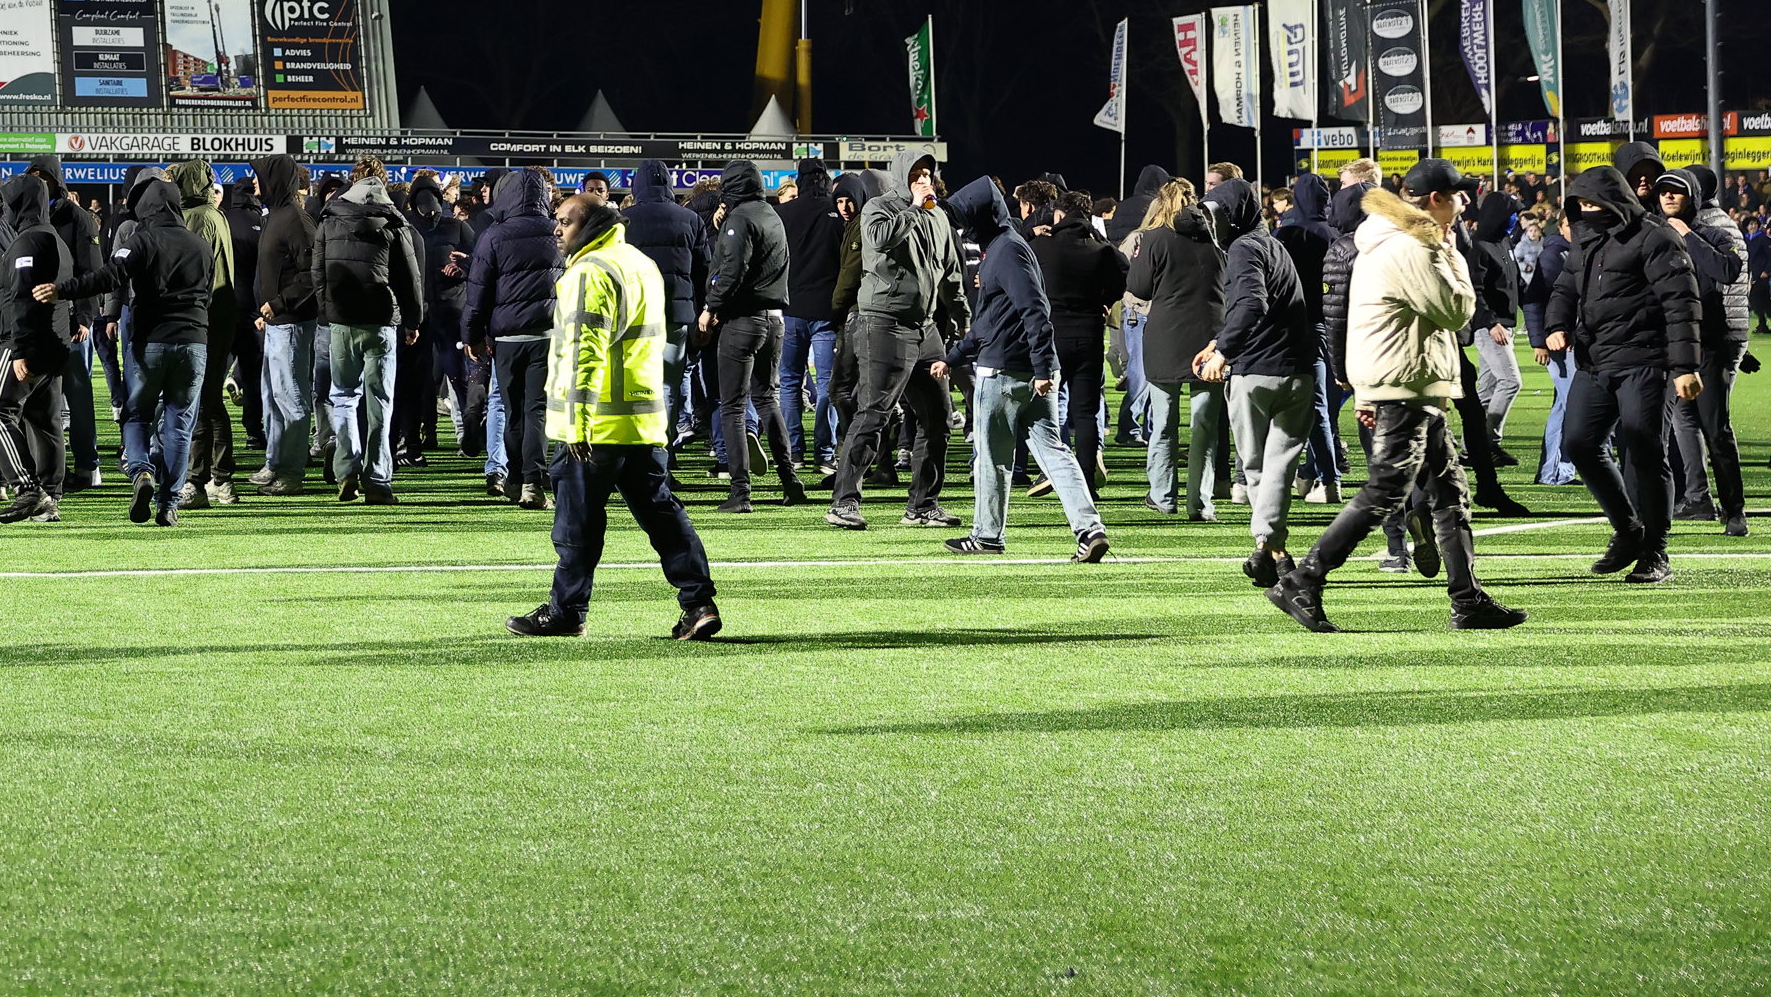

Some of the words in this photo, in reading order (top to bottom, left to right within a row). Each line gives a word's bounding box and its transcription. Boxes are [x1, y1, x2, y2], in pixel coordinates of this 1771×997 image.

[286, 62, 352, 70] BRANDVEILIGHEID
[272, 95, 358, 105] perfectfirecontrol.nl
[343, 137, 387, 145] HEINEN
[389, 137, 398, 146] &
[402, 137, 453, 146] HOPMAN
[1324, 130, 1354, 146] vebo
[88, 136, 180, 151] VAKGARAGE
[191, 137, 274, 152] BLOKHUIS
[490, 143, 546, 152] COMFORT
[549, 144, 561, 152] IN
[565, 144, 586, 152] ELK
[589, 144, 642, 154] SEIZOEN!
[678, 142, 714, 150] HEINEN
[724, 142, 732, 150] &
[735, 142, 786, 151] HOPMAN
[848, 142, 905, 152] Bort
